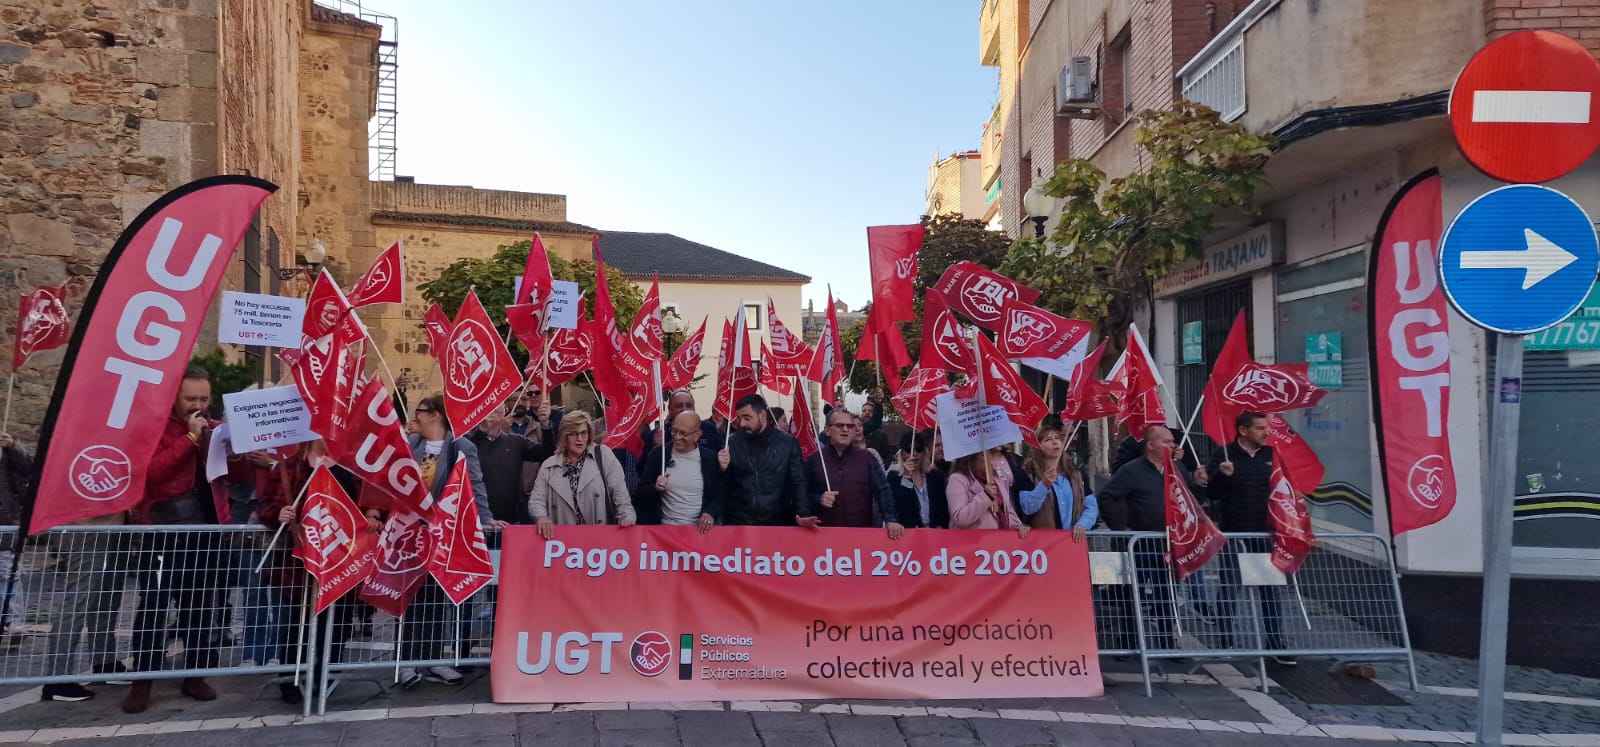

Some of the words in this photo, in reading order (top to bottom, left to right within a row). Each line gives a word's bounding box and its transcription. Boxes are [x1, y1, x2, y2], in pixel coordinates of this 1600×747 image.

[1212, 232, 1268, 273] TRAJANO
[246, 301, 260, 309] hay
[104, 217, 222, 430] UGT
[1388, 239, 1449, 437] UGT
[234, 403, 268, 413] Exigimos
[269, 397, 303, 407] negociac
[248, 412, 260, 420] NO
[280, 406, 303, 414] mesas
[462, 378, 512, 426] www.ugt.es
[255, 415, 300, 427] informativas
[253, 432, 273, 442] UGT
[543, 540, 631, 577] Pago
[640, 542, 806, 576] inmediato
[813, 548, 862, 576] del
[871, 550, 922, 576] 2%
[929, 548, 967, 576] de
[974, 549, 1049, 576] 2020
[700, 634, 753, 647] Servicios
[804, 619, 852, 648] ¡Por
[859, 624, 904, 642] una
[912, 617, 1054, 647] negociación
[516, 631, 624, 676] UGT
[700, 650, 750, 663] Públicos
[700, 666, 787, 681] Extremadura
[806, 655, 914, 680] colectiva
[922, 654, 964, 678] real
[970, 660, 985, 685] y
[990, 654, 1089, 678] efectiva!
